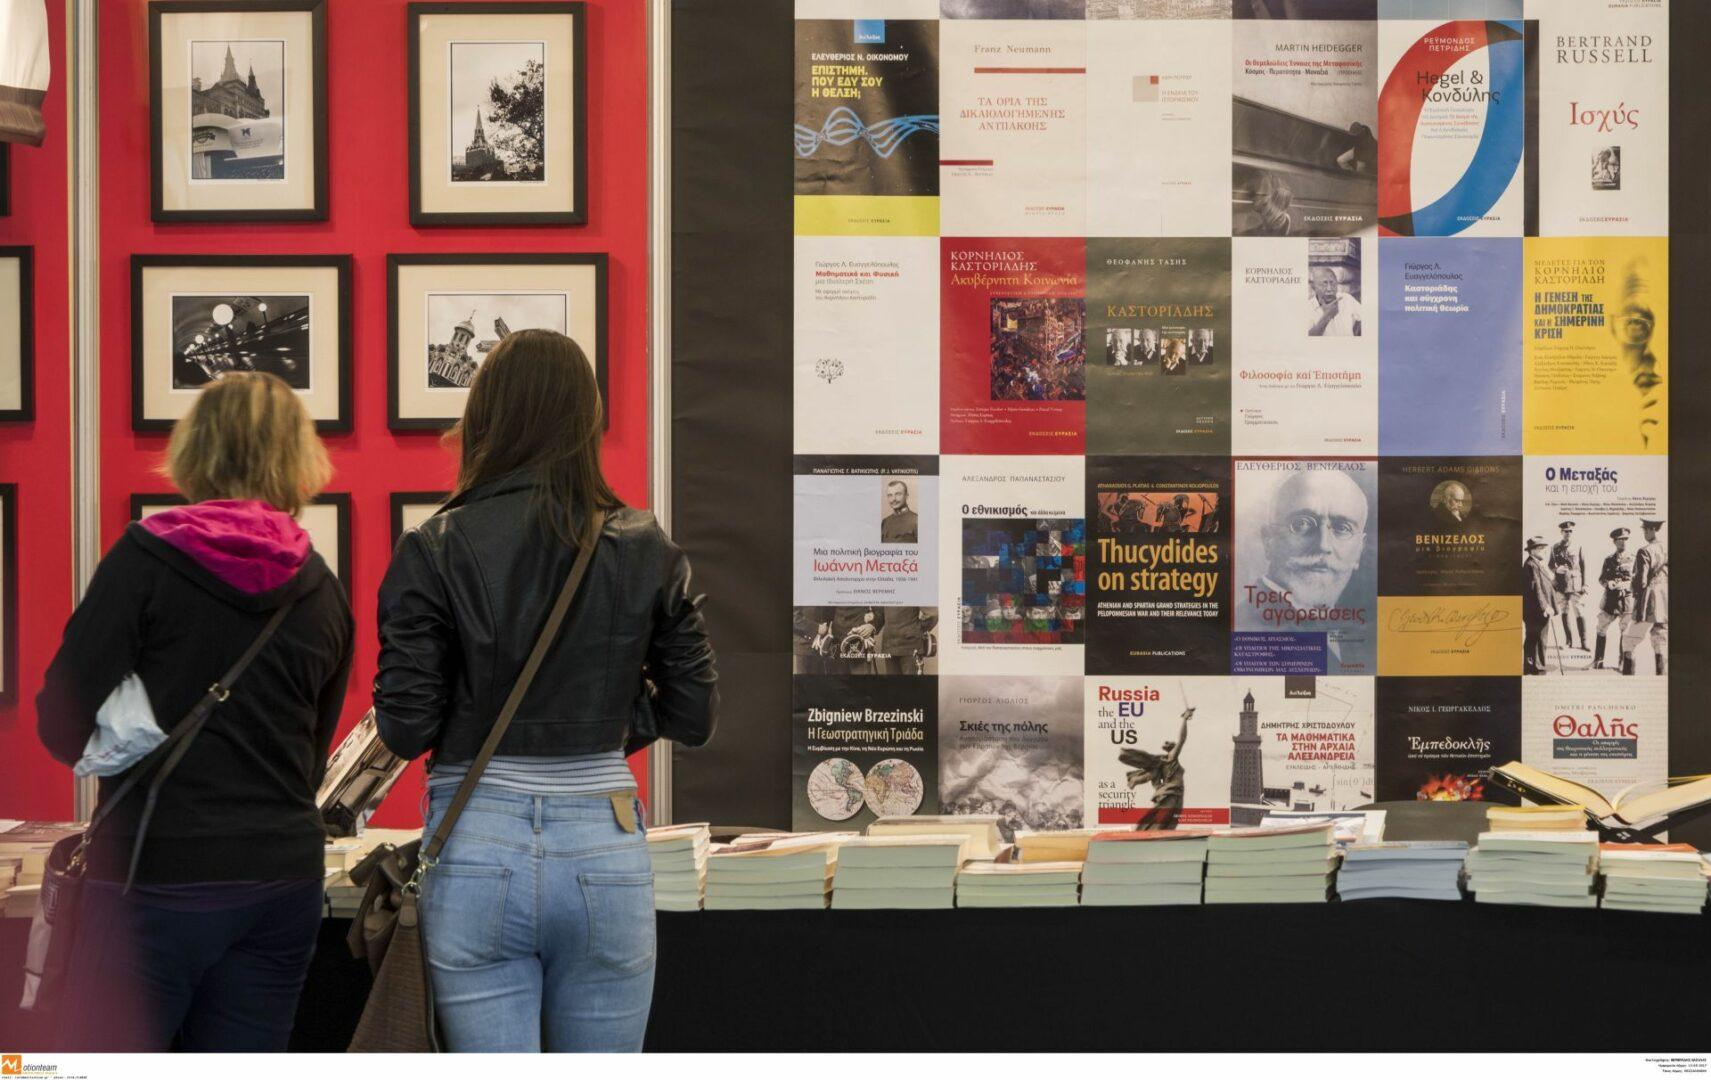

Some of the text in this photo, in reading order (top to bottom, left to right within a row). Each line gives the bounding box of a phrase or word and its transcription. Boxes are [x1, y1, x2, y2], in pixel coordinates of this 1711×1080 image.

[1557, 36, 1652, 47] BERTRAND
[975, 45, 1051, 54] Franz Neumann
[1557, 50, 1652, 63] RUSSELL
[812, 76, 832, 86] ΠΟΥ
[861, 76, 882, 86] ΣΟΥ
[1417, 70, 1483, 87] Hegel &
[812, 88, 819, 98] Η
[978, 97, 1048, 106] ΤΑ ΟΡΙΑ ΤΗΣ
[960, 109, 1065, 118] ΔΙΚΑΙΟΛΟΓΗΜΕΝΗΣ
[1570, 102, 1639, 132] Ισχύς
[951, 251, 1024, 261] ΚΟΡΝΗΛΙΟΣ
[951, 262, 1037, 271] ΚΑΣΤΟΡΙΑΔΗΣ
[1535, 266, 1604, 274] ΚΟΡΝΗΛΙΟ
[1535, 276, 1604, 284] ΚΑΣΤΟΡΙΑΔΗ
[1405, 294, 1417, 303] και
[1535, 292, 1592, 303] Η ΓΕΝΕΣΗ ΤΗΣ
[1107, 304, 1213, 317] ΚΑΣΤΟΡΙΑΔΗΣ
[1535, 304, 1604, 314] ΔΗΜΟΚΡΑΤΙΑΣ
[1555, 316, 1604, 327] ΣΗΜΕΡΙΝΗ
[1535, 328, 1562, 339] ΚΡΙΣΗ
[1546, 467, 1617, 483] Ο Μεταξάς
[962, 505, 1027, 516] Ο εθνικισμός
[1416, 535, 1484, 544] ΒΕΝΙΖΕΛΟΣ
[814, 548, 828, 557] Μια
[830, 548, 862, 557] πολιτική
[905, 548, 918, 557] του
[1098, 538, 1218, 570] Thucydides
[814, 559, 918, 574] Ιωάννη Μεταξά
[1098, 569, 1218, 597] on strategy
[1244, 586, 1292, 606] Τρεις
[1263, 605, 1365, 626] αγορεύσεις
[1099, 686, 1160, 701] Russia
[1098, 702, 1144, 717] the EU
[808, 708, 923, 725] Zbigniew Brzezinski
[960, 720, 1048, 734] Σκιές της πόλης
[1098, 719, 1135, 729] and the
[808, 727, 923, 742] Η Γεωστρατηγική Τριάδα
[1111, 730, 1138, 744] US
[1276, 733, 1355, 741] ΤΑ ΜΑΘΗΜΑΤΙΚΑ
[1098, 790, 1136, 801] security
[1098, 800, 1136, 813] triangle
